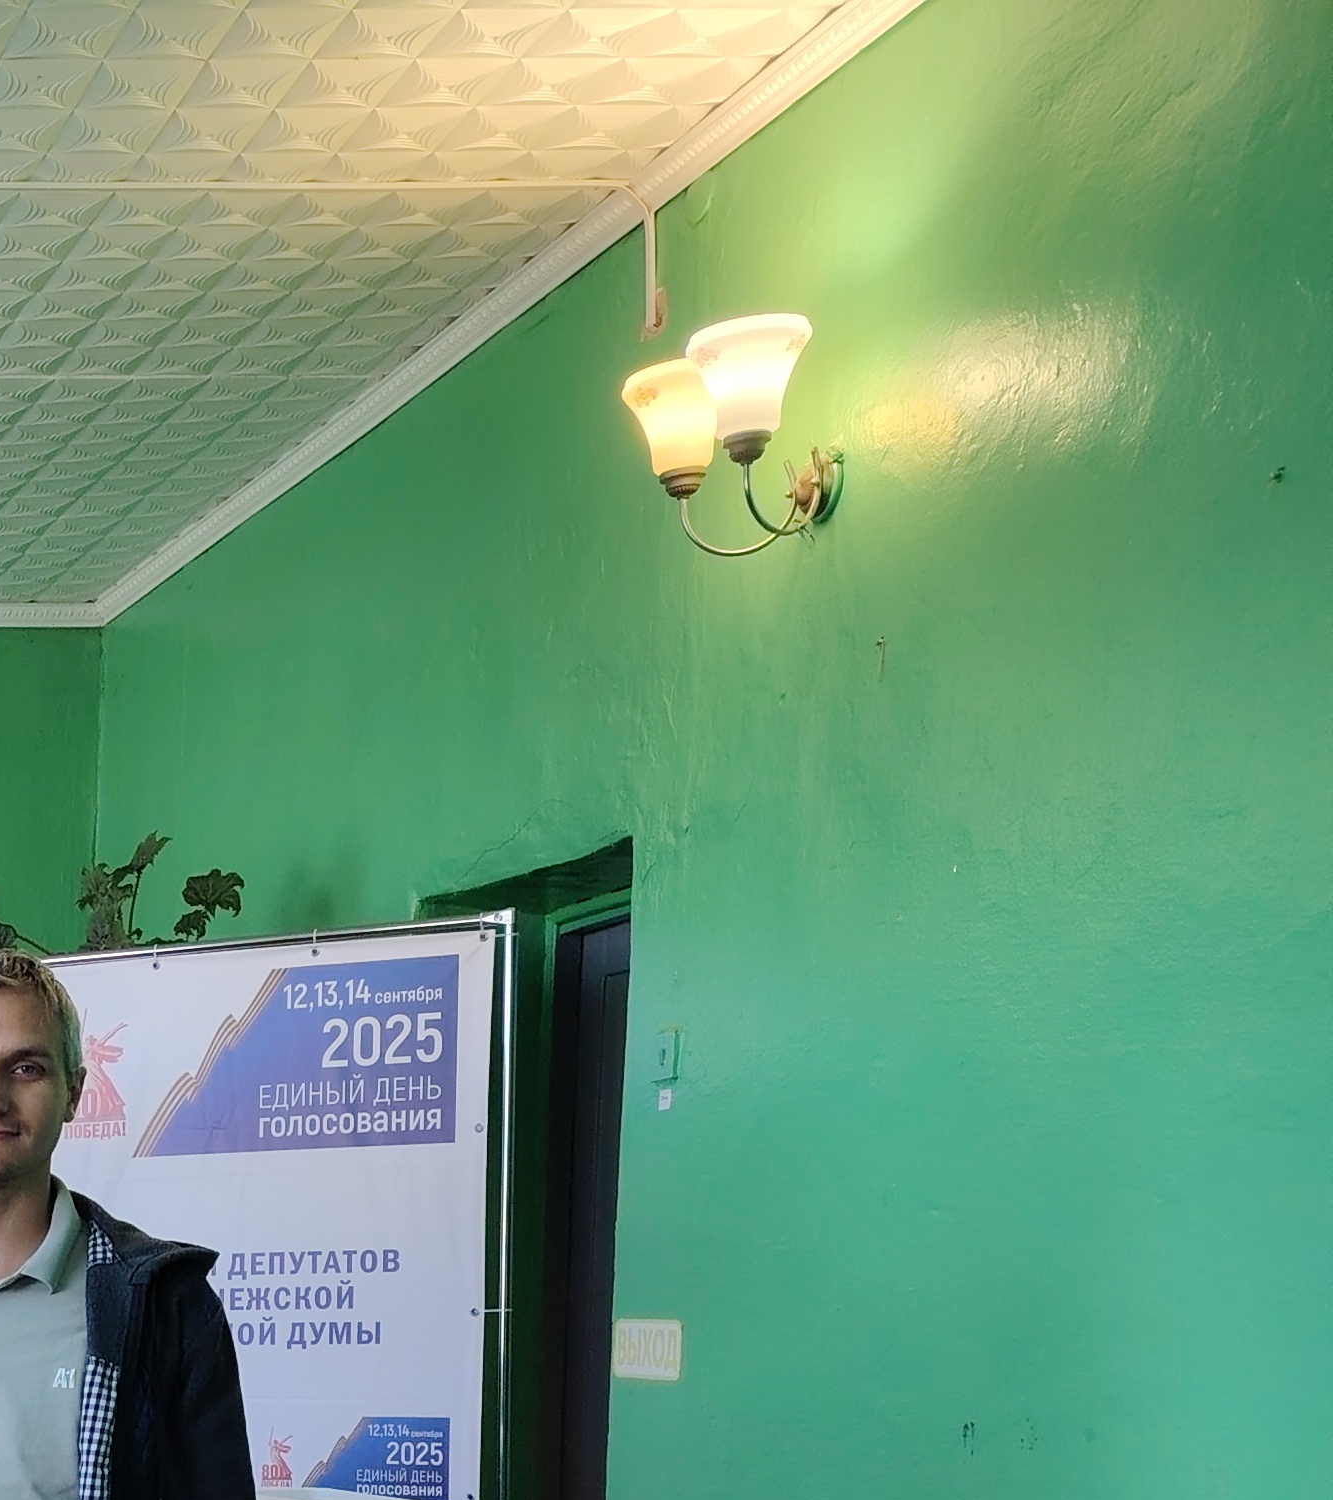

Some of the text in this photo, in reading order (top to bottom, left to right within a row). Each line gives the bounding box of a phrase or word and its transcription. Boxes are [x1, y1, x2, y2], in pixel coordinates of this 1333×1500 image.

[284, 979, 443, 1010] 12,13,14 сентября
[321, 1012, 443, 1068] 2025
[259, 1075, 442, 1110] ЕДИНЫЙ ДЕНЬ
[64, 1122, 126, 1140] ПОБЕДА!
[227, 1249, 400, 1280] ДЕПУТАТОВ
[219, 1280, 355, 1311] ЕЖСКОЙ
[230, 1316, 381, 1350] ОЙ ДУМЫ
[618, 1327, 678, 1371] ВЫХОД
[368, 1424, 410, 1438] 12,13,14
[386, 1441, 443, 1466] 2025
[262, 1464, 279, 1479] 80
[356, 1468, 443, 1484] ЕДИНЫЙ ДЕНЬ
